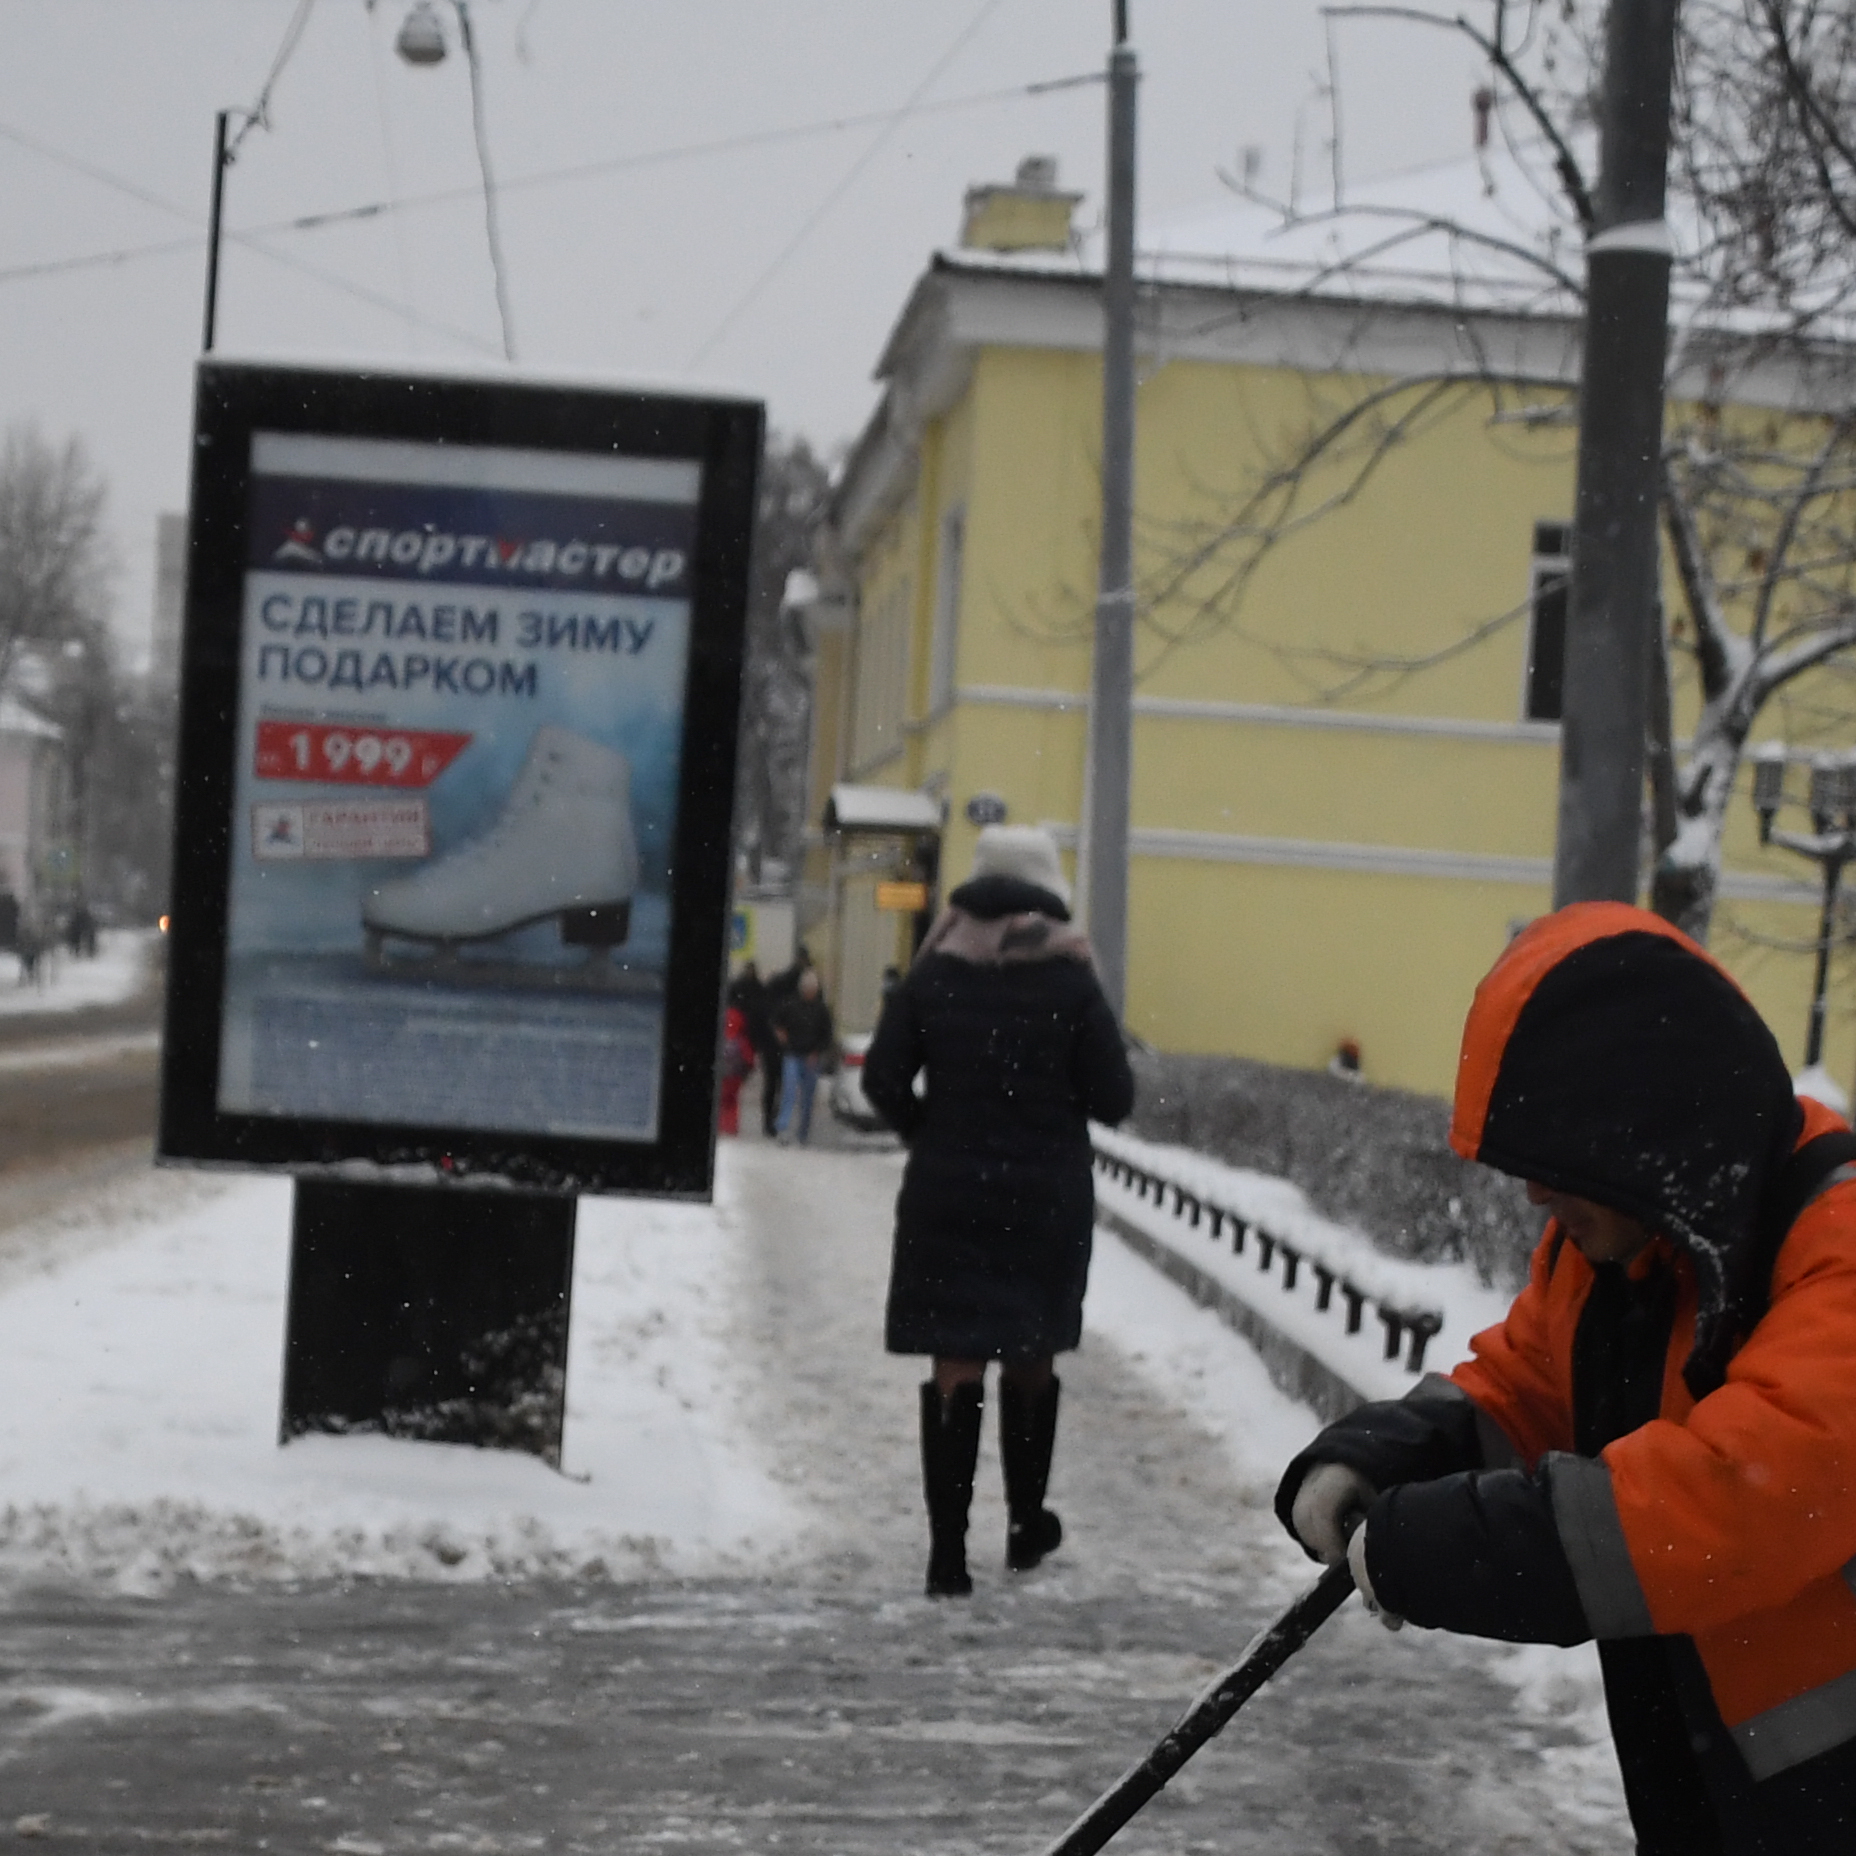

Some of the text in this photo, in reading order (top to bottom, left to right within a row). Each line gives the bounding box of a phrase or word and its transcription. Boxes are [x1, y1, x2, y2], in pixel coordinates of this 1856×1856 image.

[261, 593, 655, 656] СДЕЛАЕМ ЗИМУ
[258, 643, 539, 697] ПОДАРКОМ
